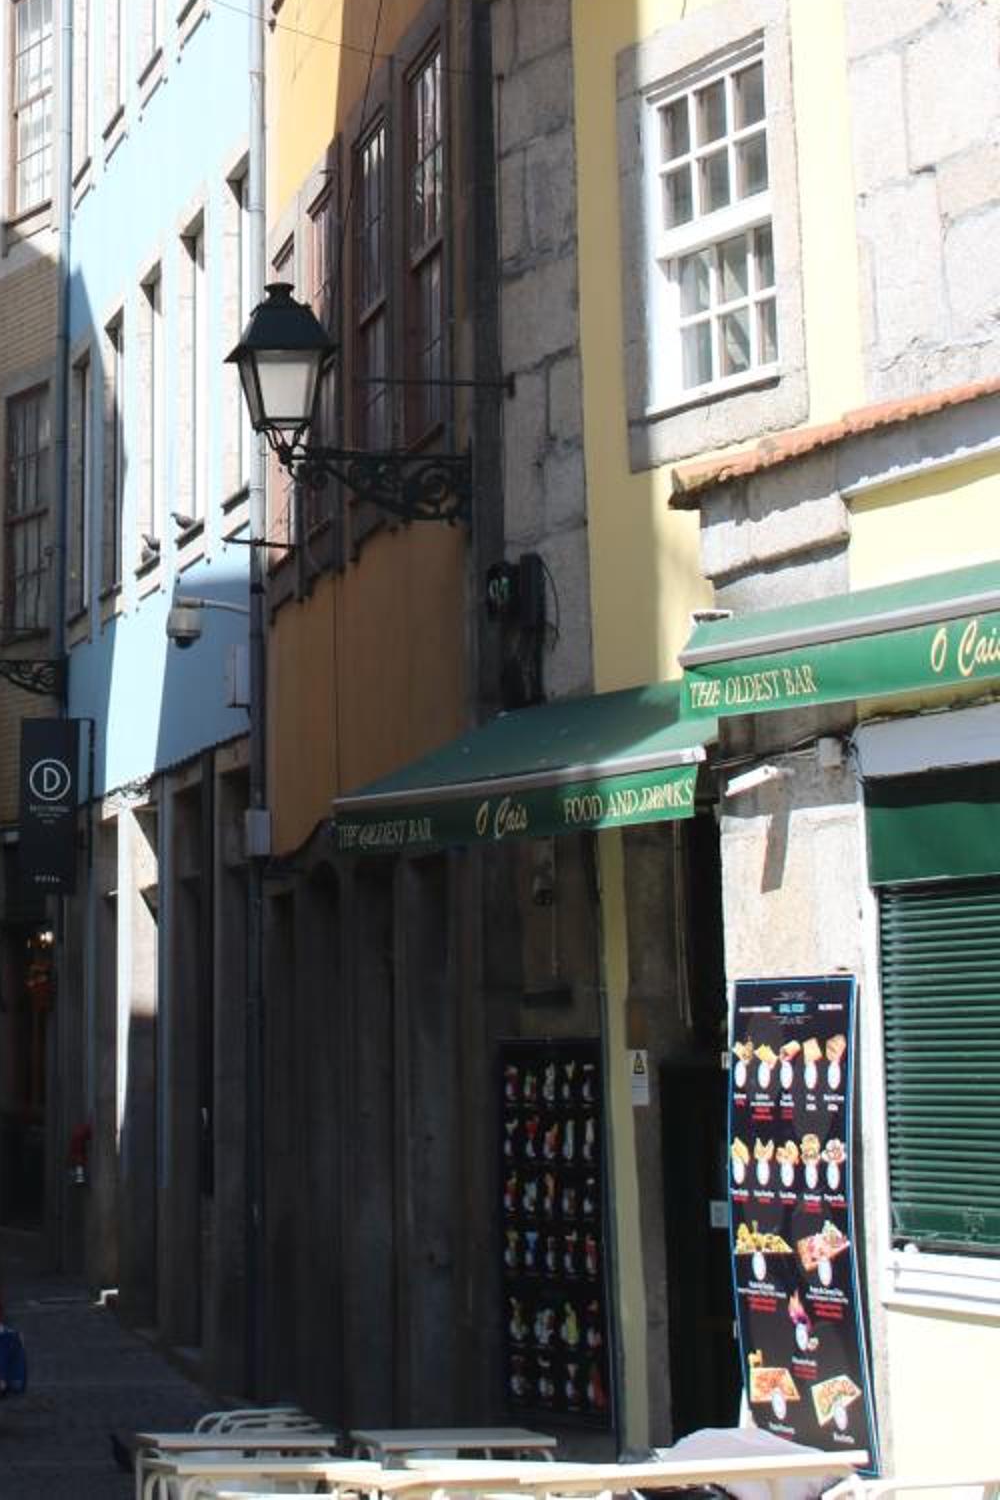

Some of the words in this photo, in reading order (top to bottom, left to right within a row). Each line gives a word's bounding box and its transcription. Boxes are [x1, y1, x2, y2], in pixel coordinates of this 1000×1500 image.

[931, 628, 947, 673] O
[689, 679, 720, 709] THE
[725, 669, 780, 706] OLDEST
[782, 664, 818, 696] BAR
[42, 766, 61, 793] D
[563, 794, 603, 824] FOOD
[607, 788, 639, 818] AND
[639, 777, 695, 812] DRINKS
[475, 801, 490, 837] O
[494, 795, 529, 841] Cais
